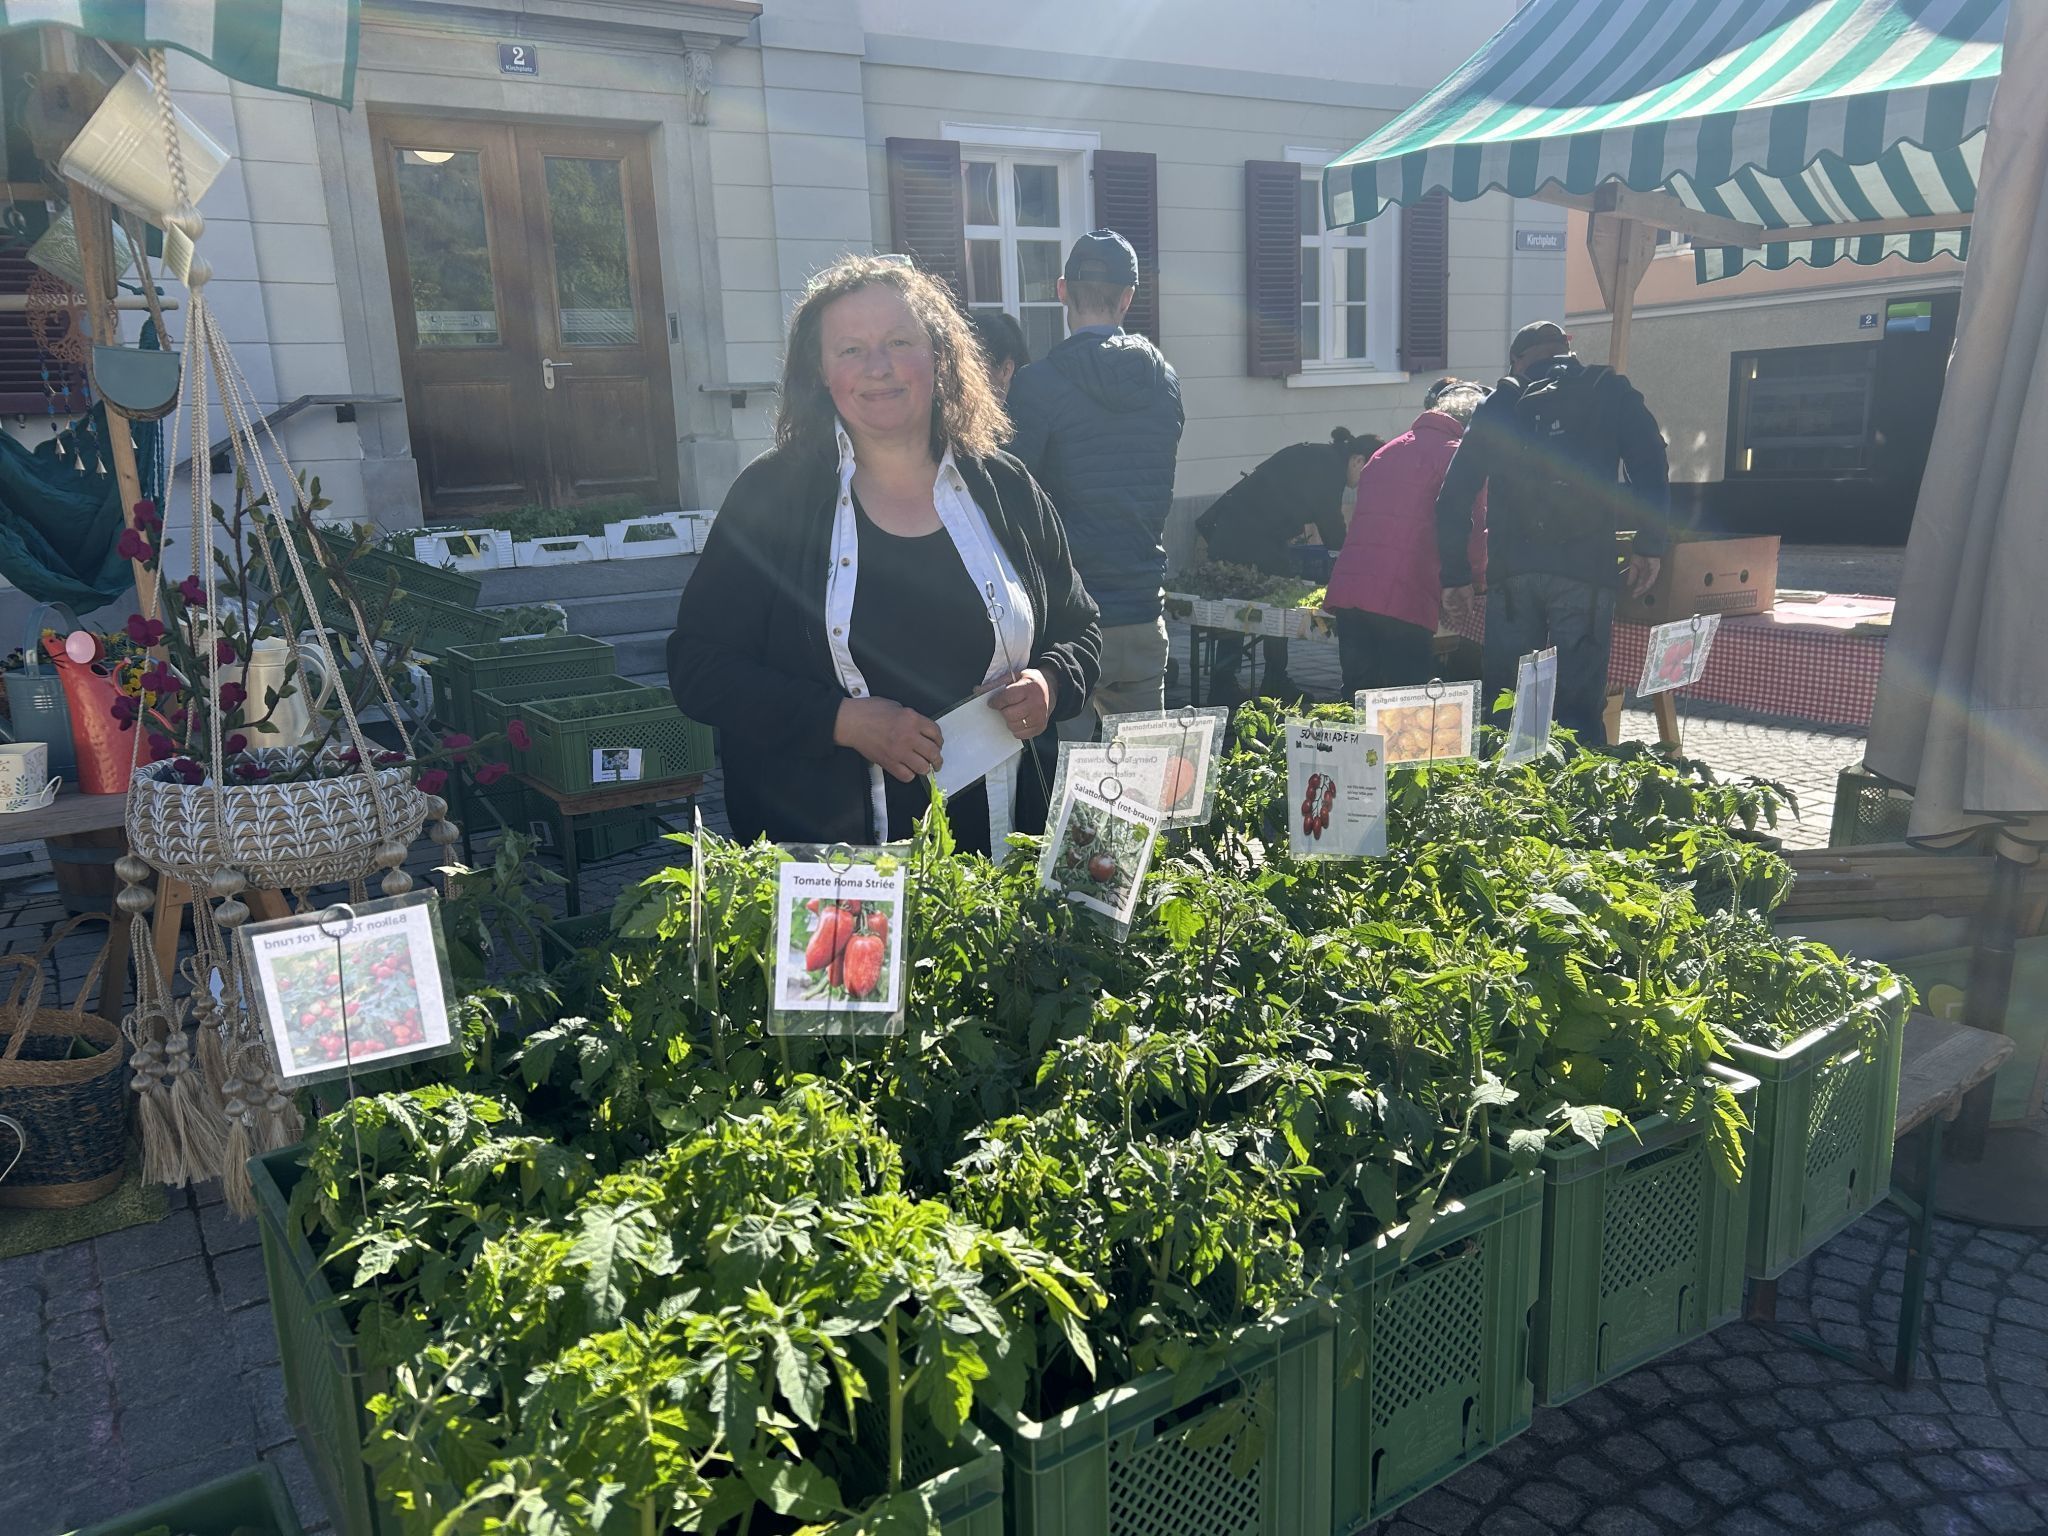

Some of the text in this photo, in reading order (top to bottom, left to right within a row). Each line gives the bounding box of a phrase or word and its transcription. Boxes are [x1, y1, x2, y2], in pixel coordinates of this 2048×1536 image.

[512, 46, 525, 65] 2
[505, 64, 533, 73] Kirchplatz
[1526, 233, 1558, 248] Kirchplatz
[1865, 314, 1872, 325] 2
[1118, 801, 1158, 826] (rot-braun)
[793, 875, 895, 890] Tomate Roma Striée
